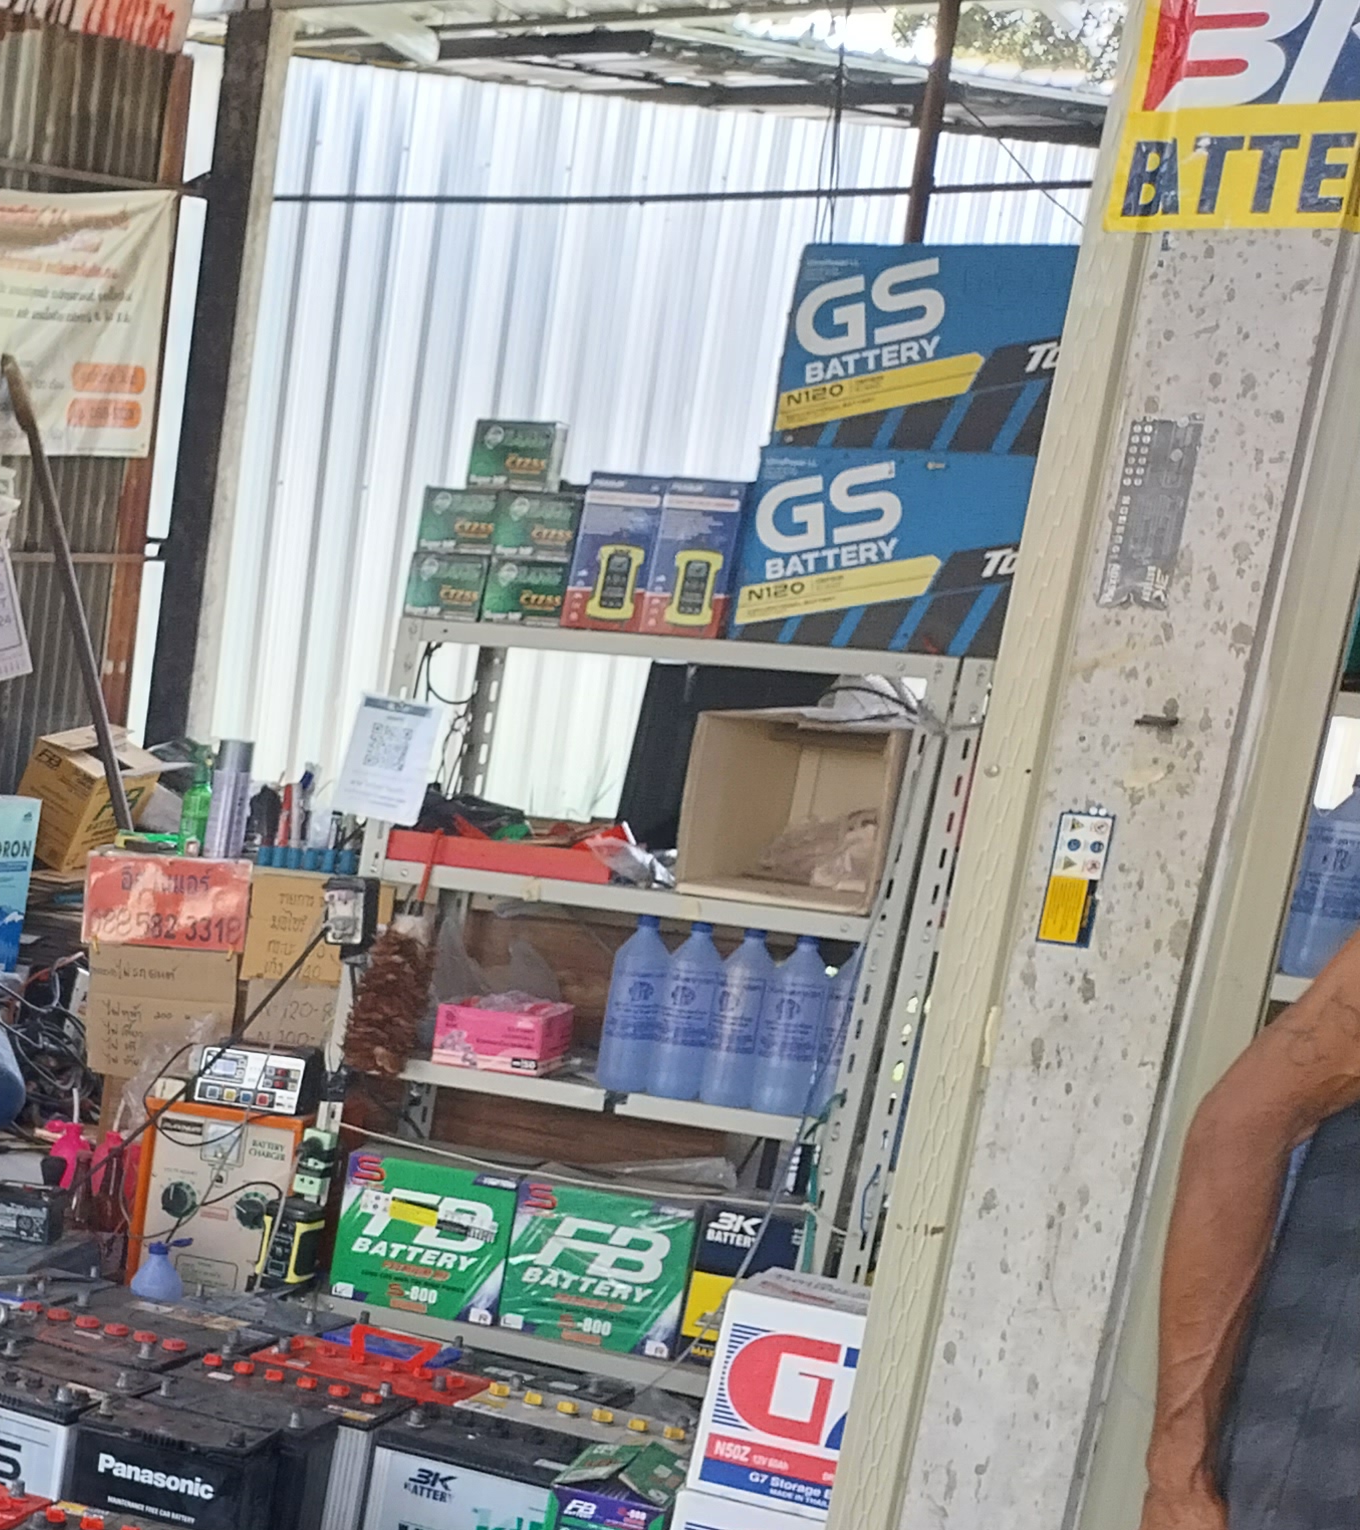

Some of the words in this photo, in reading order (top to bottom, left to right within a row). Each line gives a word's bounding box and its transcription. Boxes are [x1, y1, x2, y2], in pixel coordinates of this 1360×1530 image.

[795, 256, 946, 357] GS
[805, 335, 941, 384] BATTERY
[786, 382, 845, 408] N120
[755, 460, 902, 554] GS
[765, 537, 899, 579] BATTERY
[746, 580, 806, 602] N120
[136, 911, 177, 940] 582
[248, 1148, 286, 1161] CHARGER
[252, 1140, 285, 1153] BATTERY
[708, 1211, 764, 1236] 3K
[533, 1216, 671, 1284] FB
[706, 1229, 757, 1249] BATTER
[351, 1237, 478, 1271] BATTERY
[387, 1283, 437, 1304] S-800
[521, 1266, 653, 1303] BATTERY
[714, 1440, 752, 1463] N50Z
[98, 1454, 215, 1500] Panasonic
[408, 1468, 458, 1491] 3K
[749, 1472, 769, 1485] G7
[770, 1474, 822, 1497] Storage
[565, 1499, 597, 1515] FB
[769, 1488, 794, 1500] MADE
[795, 1492, 804, 1502] IN
[108, 1496, 144, 1513] MAINTENANCE
[145, 1504, 159, 1516] FREE
[159, 1507, 171, 1518] CAR
[171, 1510, 196, 1525] BATTERY
